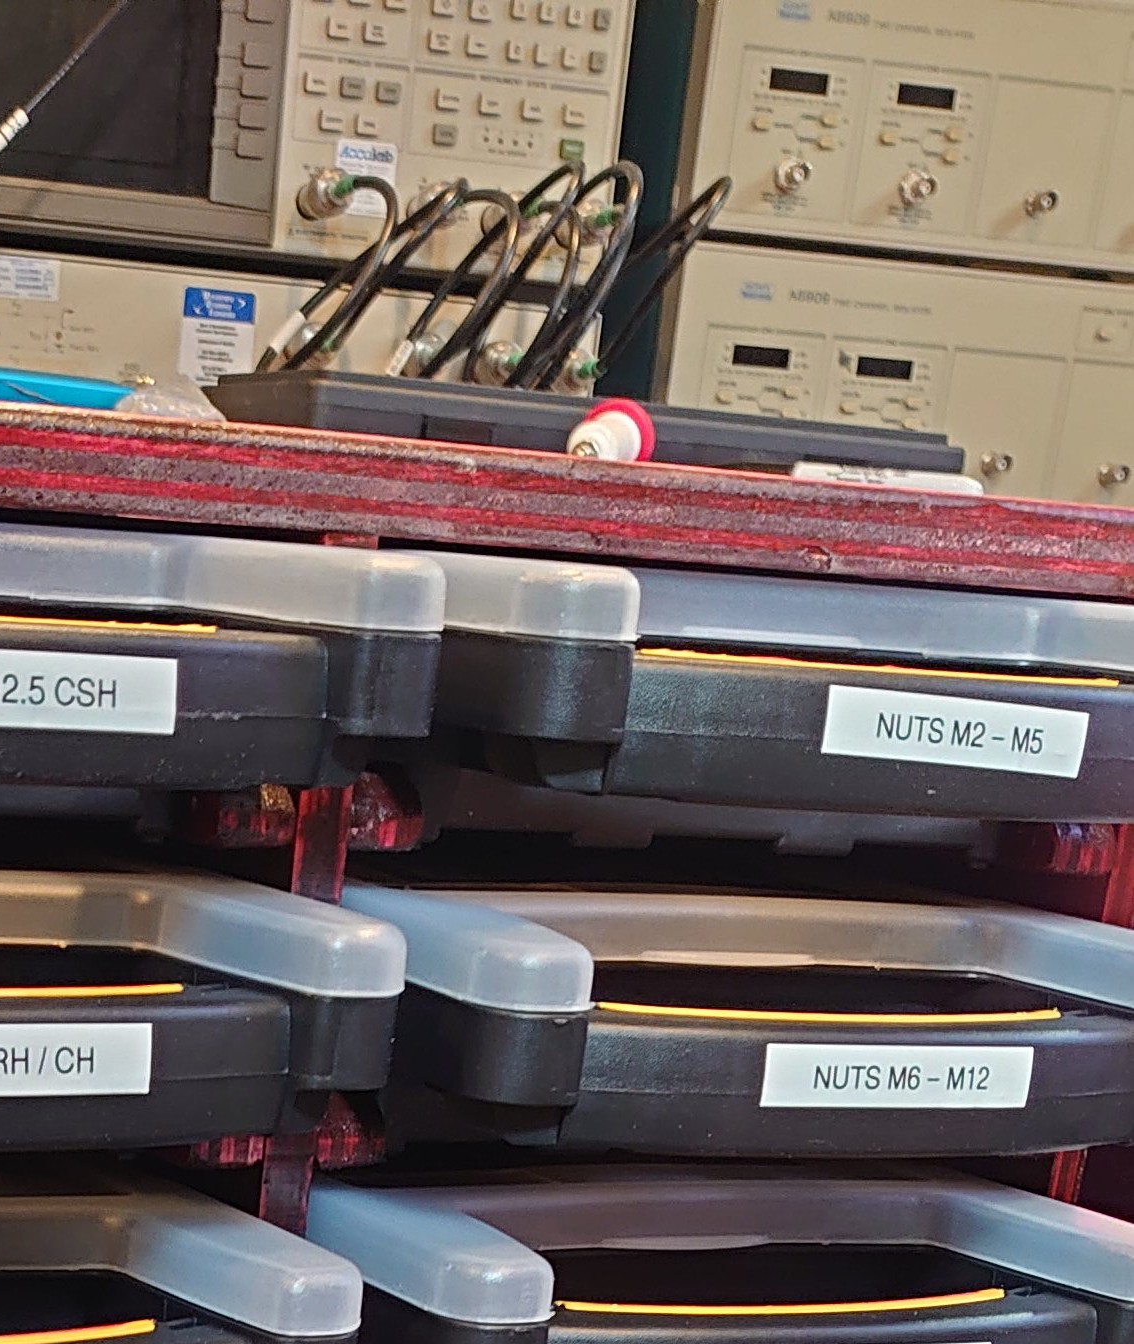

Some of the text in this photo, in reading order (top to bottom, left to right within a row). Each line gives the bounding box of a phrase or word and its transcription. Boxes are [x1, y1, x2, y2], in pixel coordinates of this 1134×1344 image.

[54, 676, 117, 709] CSH
[876, 712, 945, 744] NUTS
[950, 719, 986, 749] M2
[1010, 725, 1044, 755] M5
[37, 1046, 48, 1075] /
[54, 1046, 95, 1075] CH
[813, 1064, 881, 1091] NUTS
[887, 1065, 921, 1091] M6
[946, 1065, 990, 1091] M12
